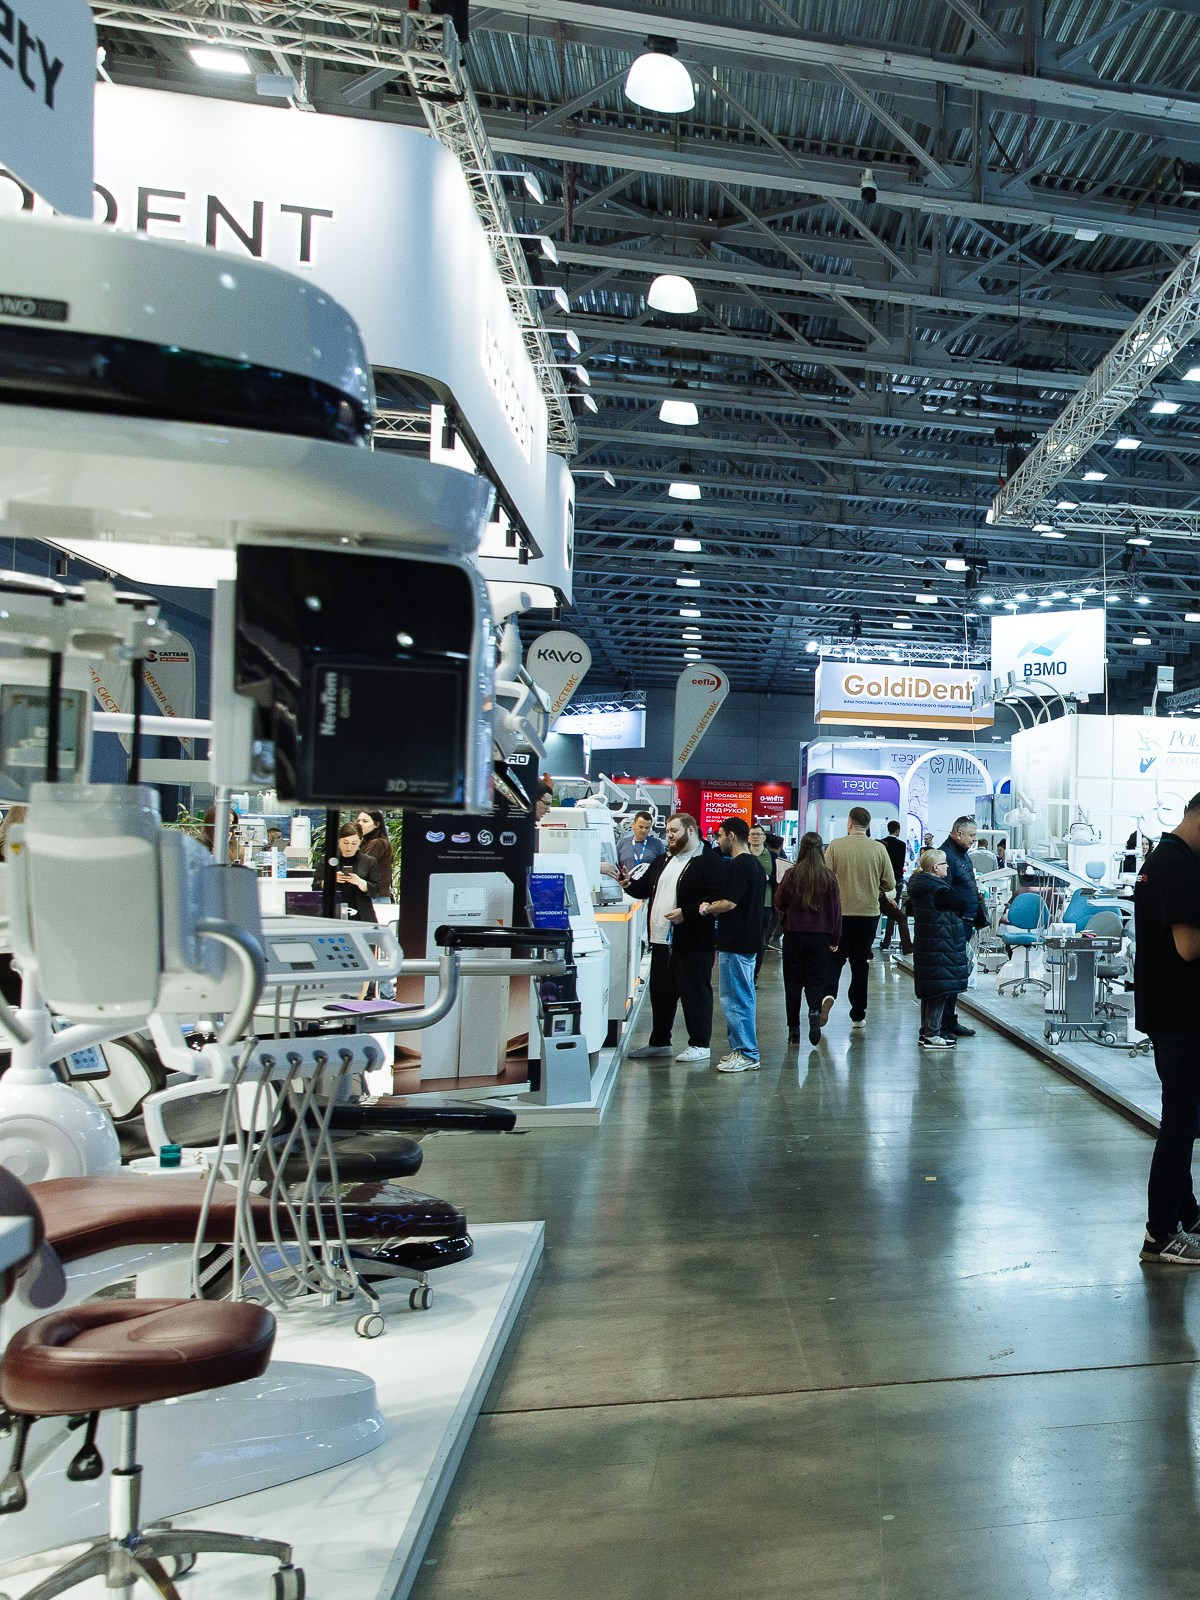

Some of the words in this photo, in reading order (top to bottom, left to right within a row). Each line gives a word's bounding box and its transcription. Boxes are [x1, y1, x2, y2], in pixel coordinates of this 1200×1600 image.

[319, 671, 338, 736] NewTom
[551, 674, 580, 714] СИСТЕМС
[844, 674, 973, 701] GoldiDent
[679, 734, 699, 764] ДЕНТАЛ
[696, 700, 719, 734] СИСТЕМС
